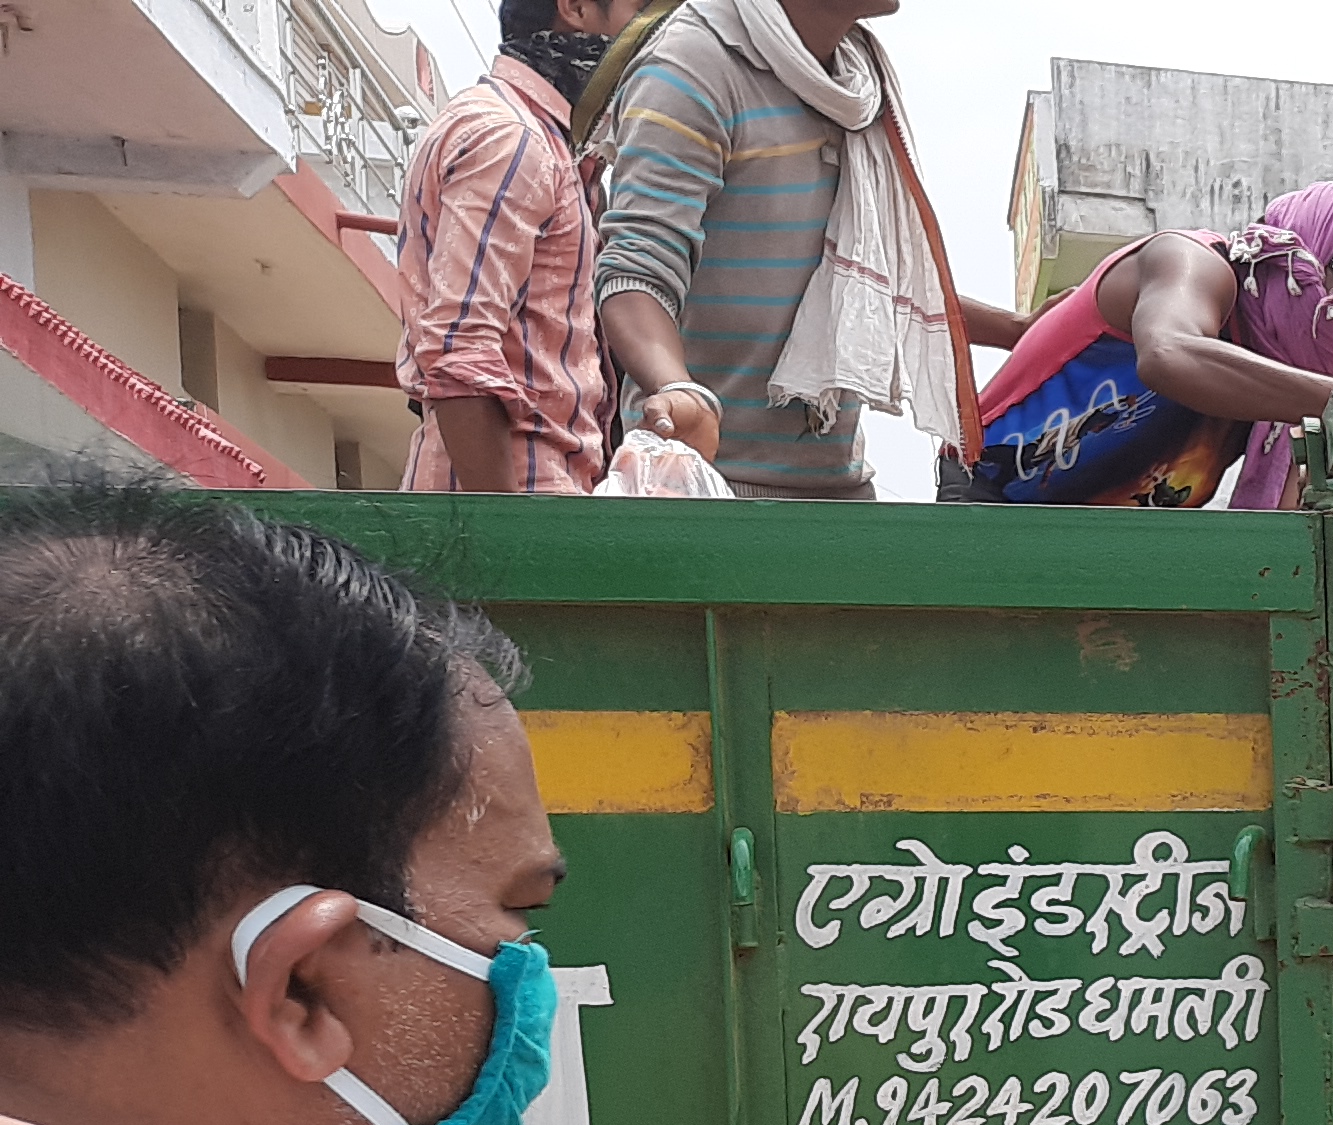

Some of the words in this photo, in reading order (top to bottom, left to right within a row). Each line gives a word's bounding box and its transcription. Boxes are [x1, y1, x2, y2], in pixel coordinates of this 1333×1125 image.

[795, 840, 973, 948] एग्रो
[797, 984, 988, 1072] रायपुर
[982, 960, 1083, 1051] रोड
[1079, 955, 1270, 1050] धमतरी
